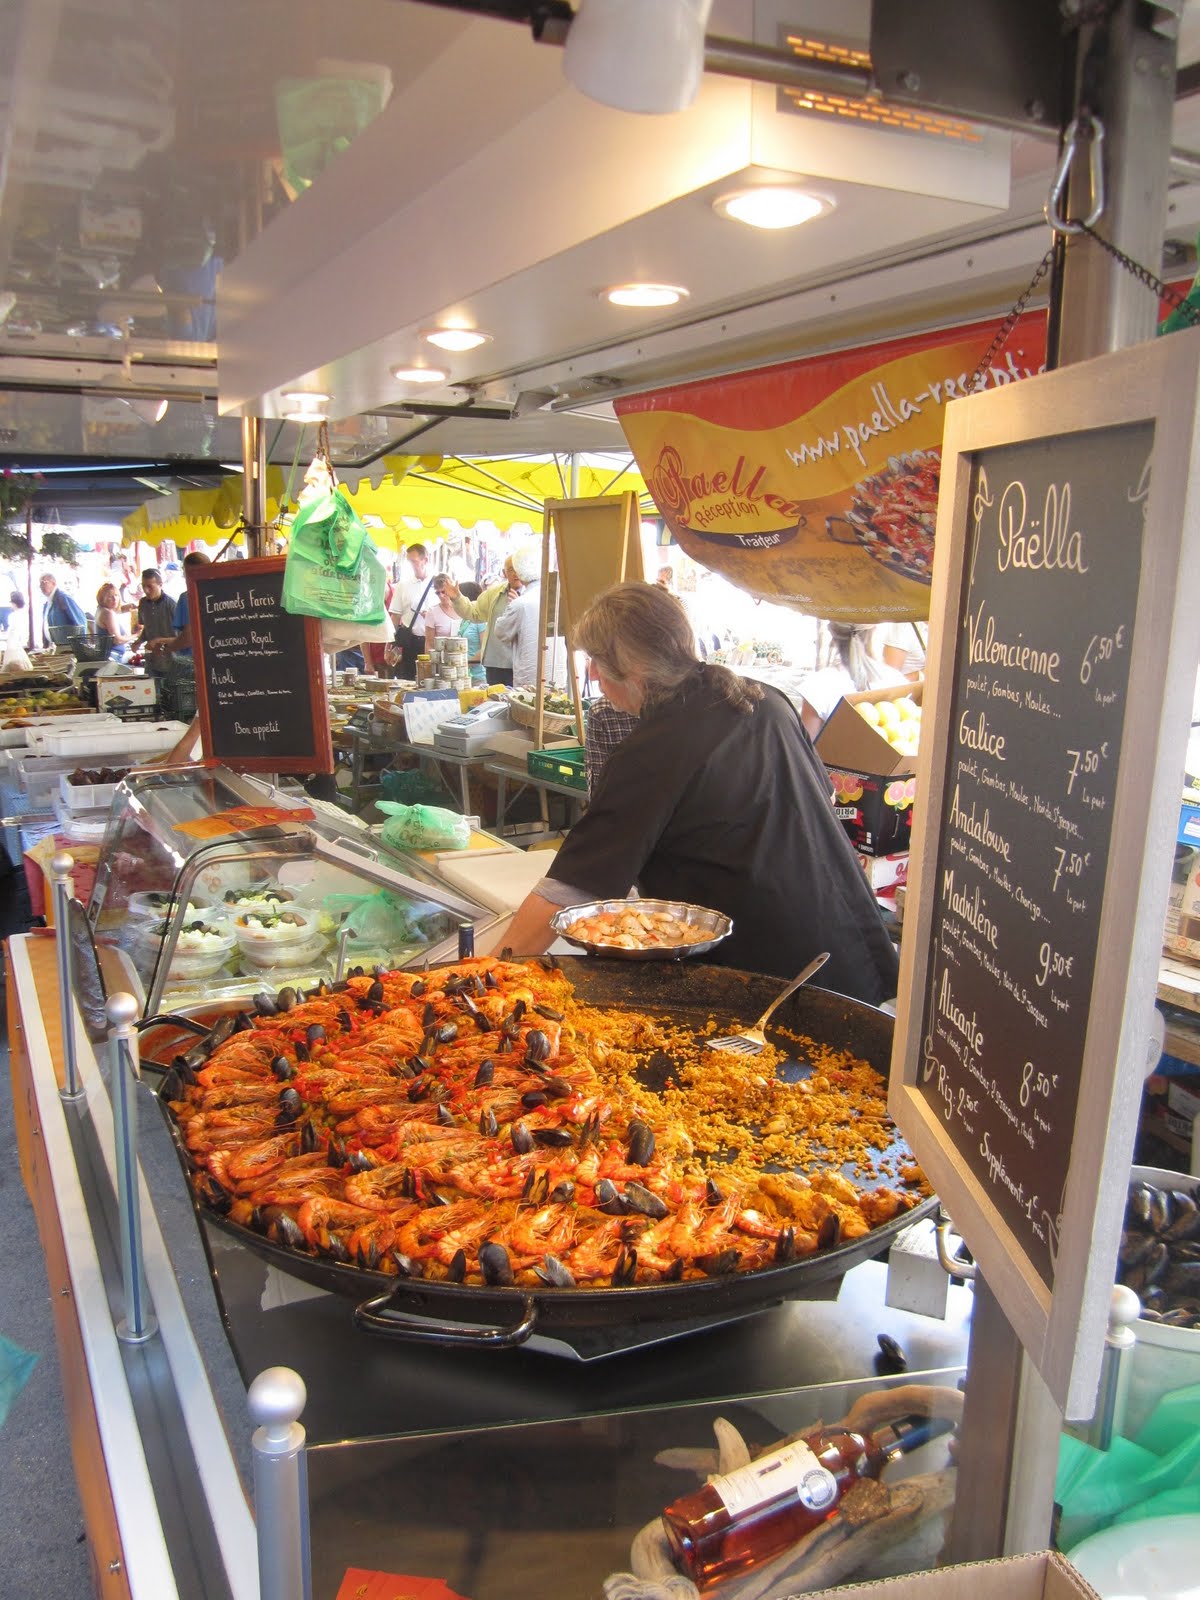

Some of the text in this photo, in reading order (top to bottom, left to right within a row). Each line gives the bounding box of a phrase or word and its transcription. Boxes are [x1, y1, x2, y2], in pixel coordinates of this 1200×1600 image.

[652, 443, 801, 525] Paella
[695, 496, 760, 528] Réception
[998, 480, 1089, 574] Paëlla
[735, 533, 781, 549] Traiteur
[249, 589, 275, 607] Farcis
[208, 631, 275, 649] Couscous Royal
[234, 721, 280, 741] Bon appétit
[959, 710, 1006, 761] Galice
[949, 784, 1012, 863] Andalouse
[943, 870, 998, 950] Madrilène
[938, 967, 984, 1056] Alicante
